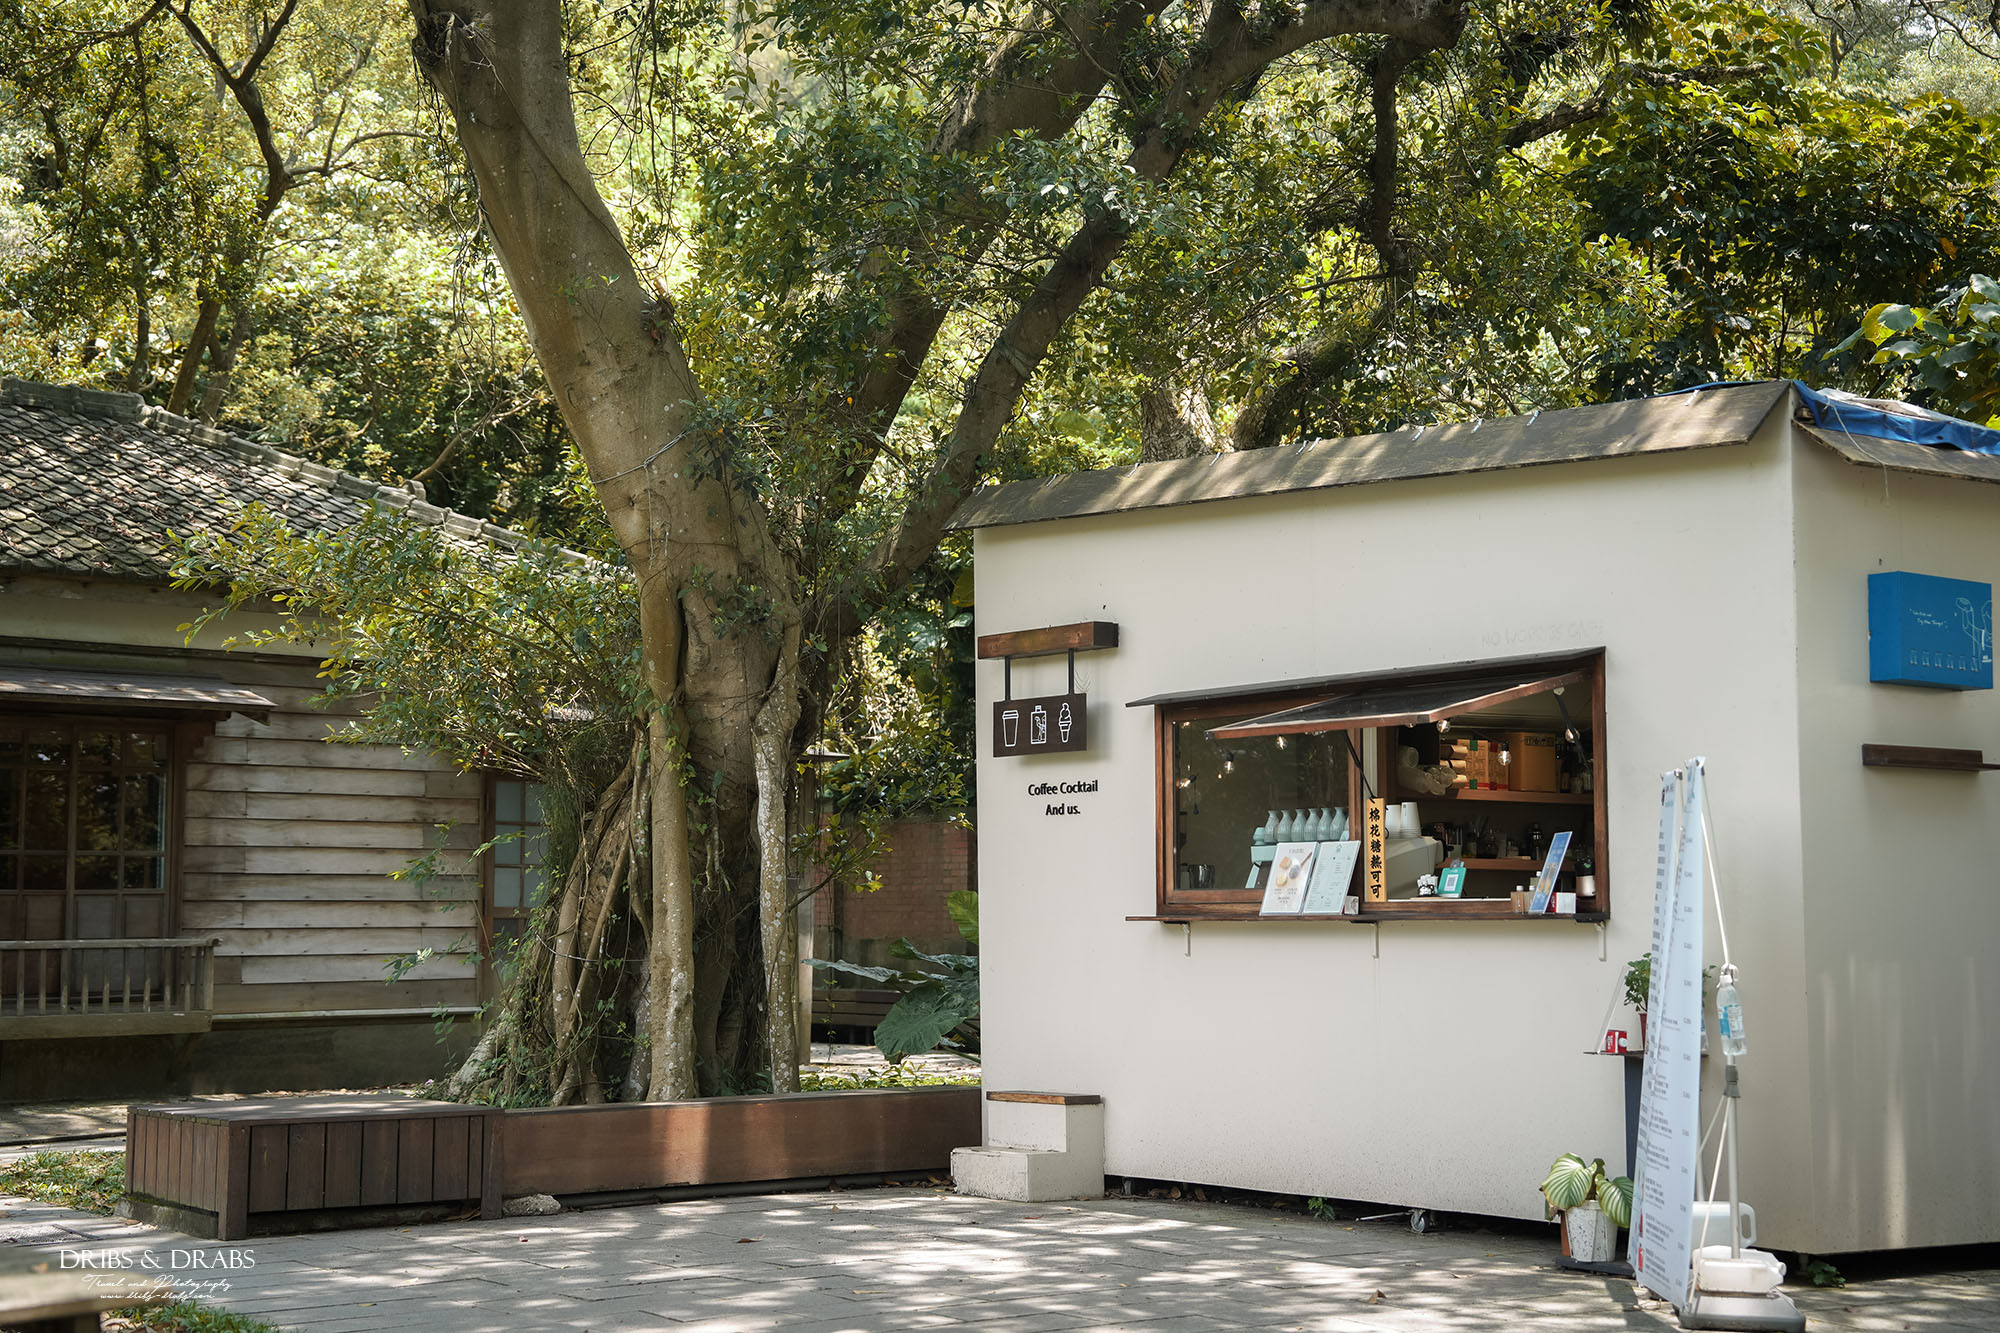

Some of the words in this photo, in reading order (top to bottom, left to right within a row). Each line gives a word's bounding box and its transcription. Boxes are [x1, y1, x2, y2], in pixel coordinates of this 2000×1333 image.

[1028, 783, 1058, 796] Coffee
[1060, 780, 1098, 794] Cocktail
[1045, 803, 1065, 816] And
[1067, 805, 1081, 815] us.
[1369, 808, 1382, 899] 棉花糖熱可可
